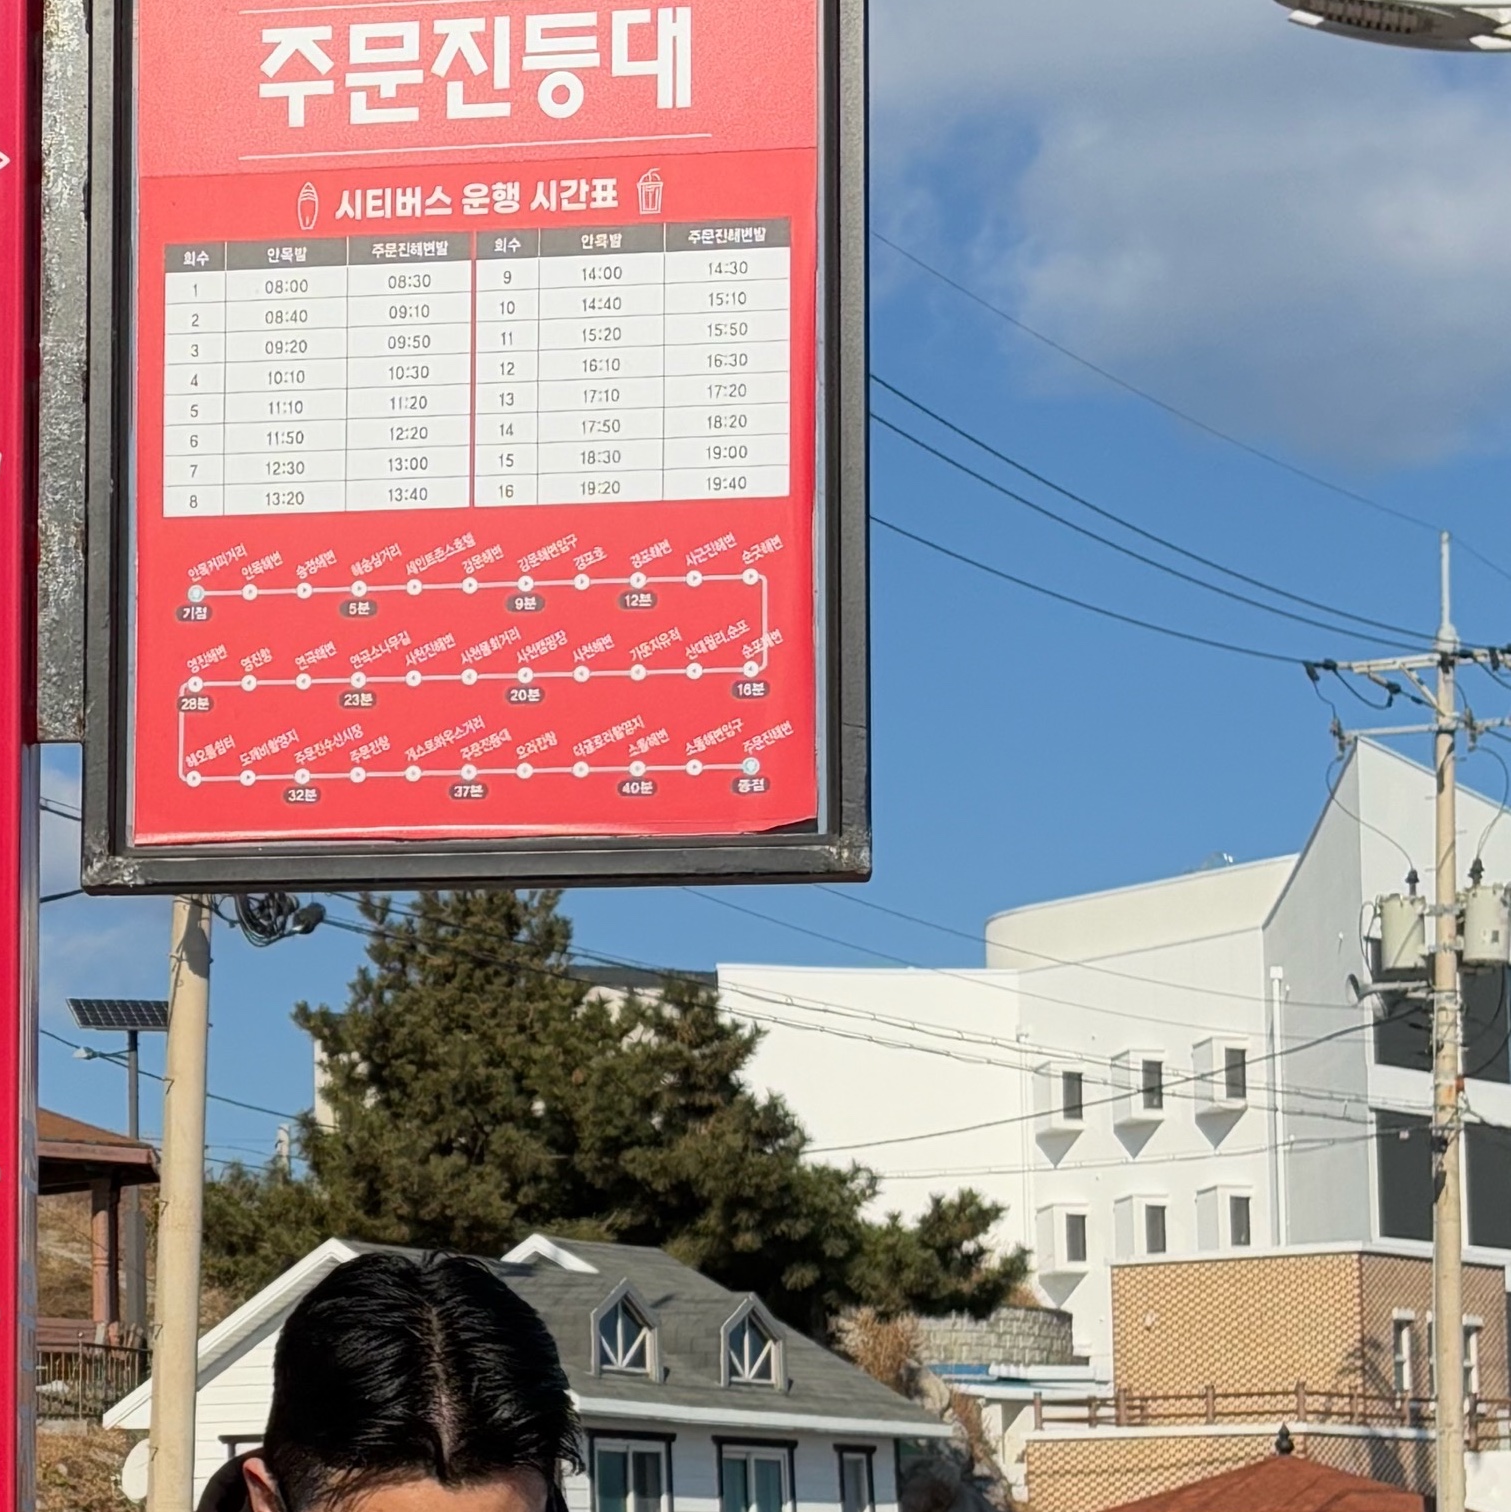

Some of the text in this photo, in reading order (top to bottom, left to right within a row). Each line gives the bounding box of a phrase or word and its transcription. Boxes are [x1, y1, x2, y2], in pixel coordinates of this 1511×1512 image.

[257, 8, 693, 128] 주문진등대
[335, 176, 620, 221] 시티버스 운행 시간표
[494, 227, 767, 253] 회수 안목발 주문진해변발
[183, 240, 449, 267] 회수 안목발 주문진해변발
[193, 273, 432, 297] 1 08:00 08:30
[503, 260, 749, 285] 9 14:00 14:30
[191, 303, 430, 328] 2 08:40 09:10
[500, 291, 747, 315] 10 14:40 15:10
[191, 334, 431, 358] 3 09:20 09:50
[501, 321, 749, 346] 11 15:20 15:50
[190, 365, 430, 387] 4 10:10 10:30
[500, 352, 748, 376] 12 16:10 16:30
[190, 395, 428, 418] 5 11:10 11:20
[499, 383, 747, 407] 13 17:10 17:20
[189, 426, 429, 448] 6 11:50 12:20
[499, 414, 748, 436] 14 17:50 18:20
[189, 456, 429, 478] 7 12:30 13:00
[499, 445, 748, 468] 15 18:30 19:00
[189, 487, 428, 509] 8 13:20 13:40
[499, 475, 747, 499] 16 19:20 19:40
[350, 542, 402, 577] 해송삼거리
[405, 531, 477, 576] 세인트존스호텔
[461, 543, 505, 574] 강문해변
[516, 533, 578, 573] 강문해변입구
[572, 545, 608, 571] 경포호
[629, 538, 673, 569] 경포해변
[685, 531, 738, 567] 사근진해변
[741, 534, 784, 565] 순긋해변
[187, 542, 248, 582] 안목커피거리
[241, 551, 284, 580] 안목해변
[295, 549, 338, 579] 송정해변
[348, 602, 371, 616] 5분
[514, 597, 537, 610] 9분
[624, 593, 653, 607] 12분
[182, 606, 208, 620] 기점
[186, 644, 229, 674] 영진해변
[240, 647, 274, 673] 영진항
[294, 640, 338, 670] 연곡해변
[349, 630, 412, 670] 연곡소나무길
[405, 632, 457, 667] 사천진해변
[572, 633, 616, 663] 사천해변
[343, 692, 373, 707] 23분
[509, 688, 541, 702] 20분
[736, 682, 766, 696] 16분
[181, 696, 210, 711] 28분
[239, 727, 300, 767] 도깨비촬영지
[293, 723, 364, 765] 주문진수산시장
[349, 734, 391, 763] 주문진항
[741, 720, 794, 755] 주문진해변
[185, 734, 237, 769] 해오름쉼터
[287, 788, 318, 802] 32분
[453, 784, 484, 798] 37분
[621, 781, 654, 795] 40분
[737, 778, 765, 792] 종점
